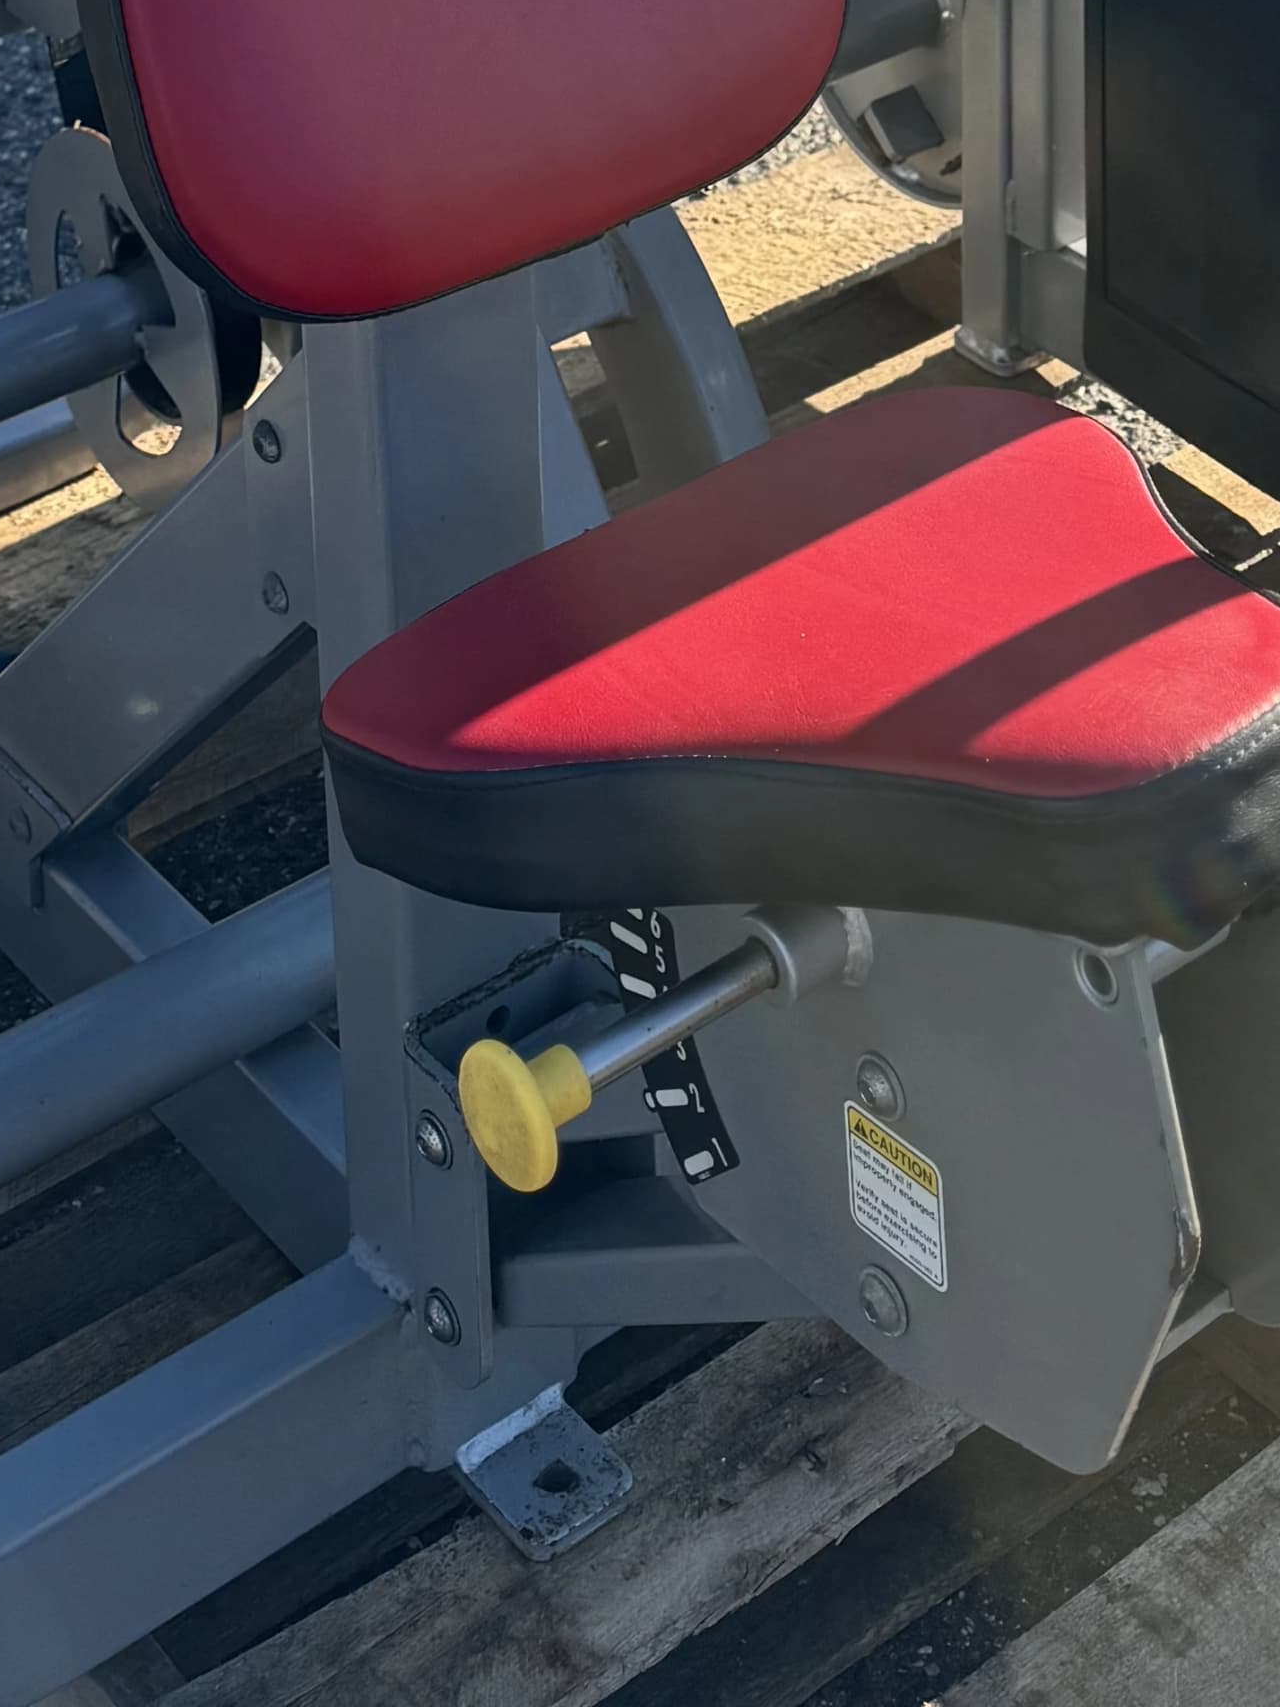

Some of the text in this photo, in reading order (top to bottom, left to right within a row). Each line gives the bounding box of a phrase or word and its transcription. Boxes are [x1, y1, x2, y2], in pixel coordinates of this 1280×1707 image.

[650, 911, 662, 939] 6
[655, 945, 666, 973] 5
[689, 1082, 705, 1113] 2
[711, 1137, 728, 1167] 1
[869, 1128, 933, 1186] CAUTION
[872, 1156, 890, 1176] may
[856, 1191, 882, 1216] before
[856, 1179, 879, 1203] Verify
[881, 1197, 899, 1217] seat
[910, 1220, 938, 1248] secure
